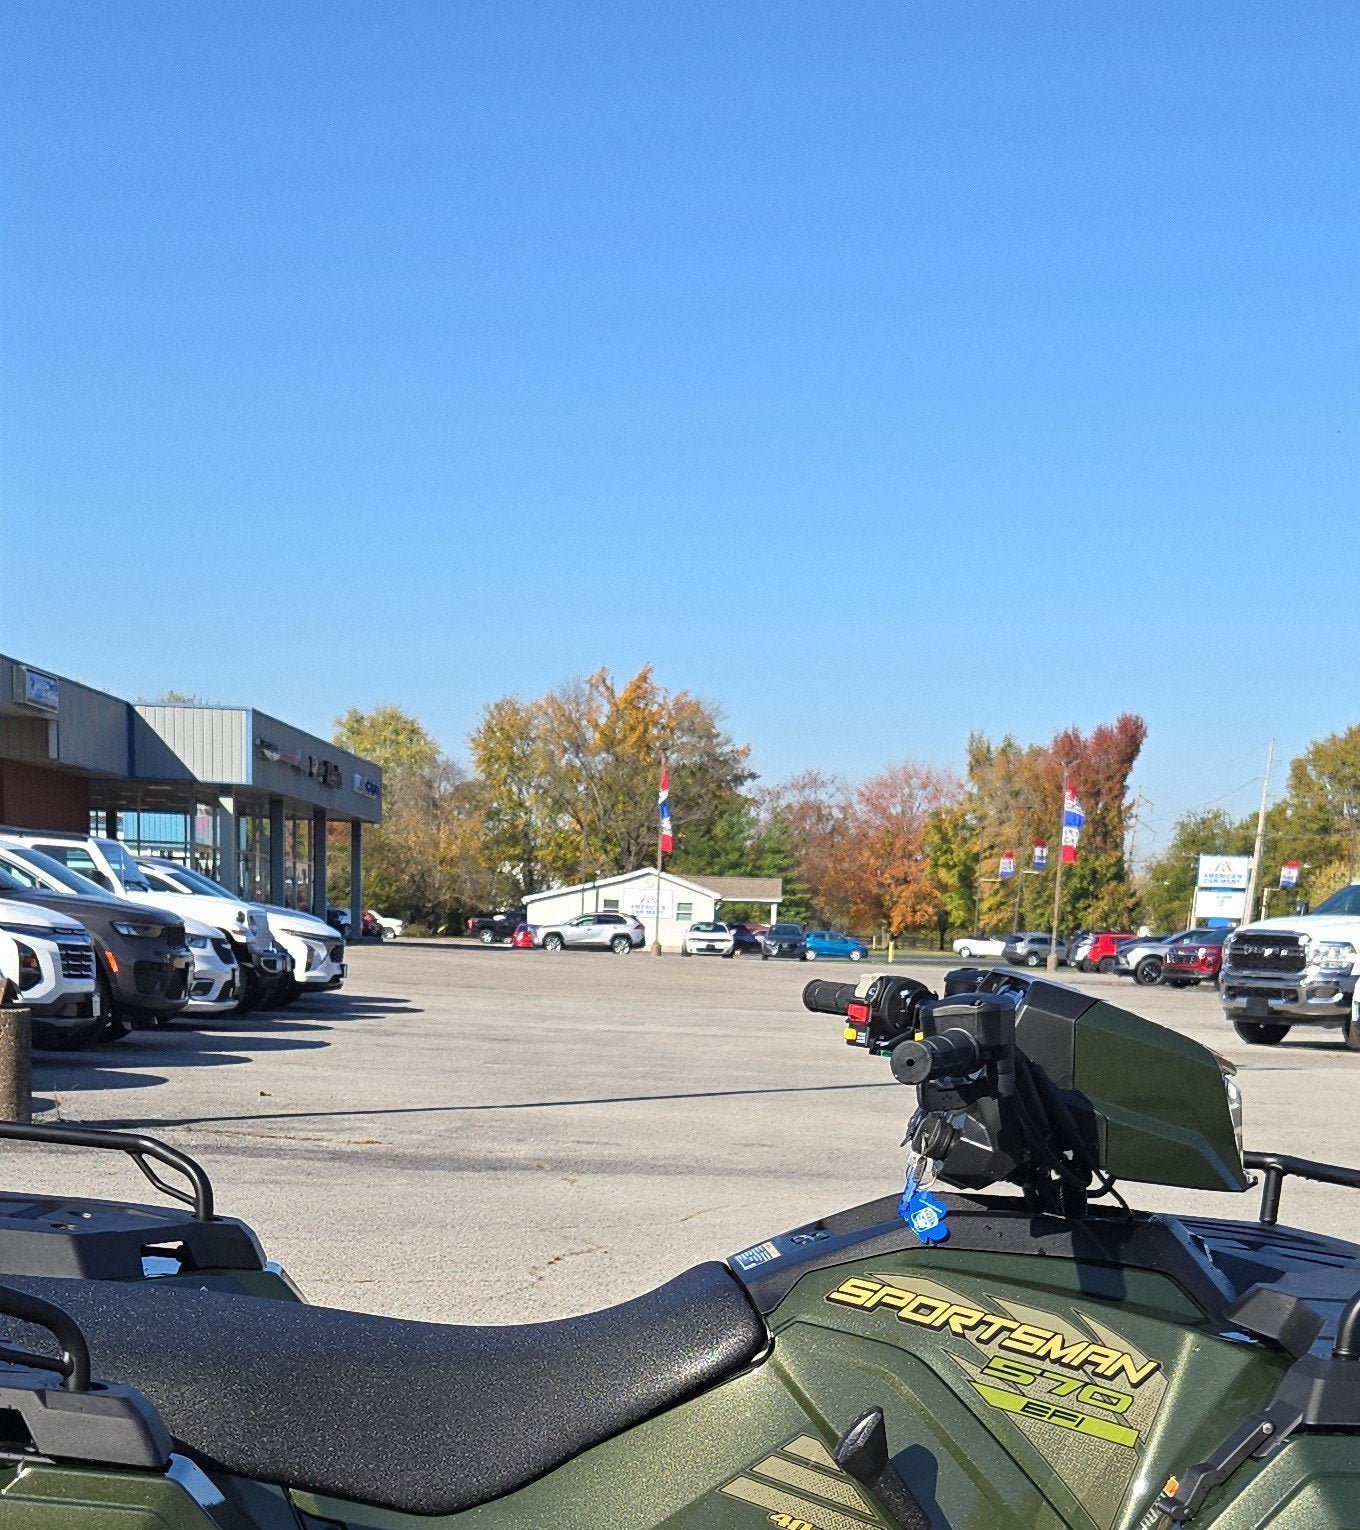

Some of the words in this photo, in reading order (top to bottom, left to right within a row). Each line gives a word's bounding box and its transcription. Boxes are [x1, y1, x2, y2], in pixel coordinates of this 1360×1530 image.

[825, 1276, 1162, 1388] SPORTSMAN
[980, 1356, 1135, 1414] 570
[1020, 1401, 1086, 1429] EFI
